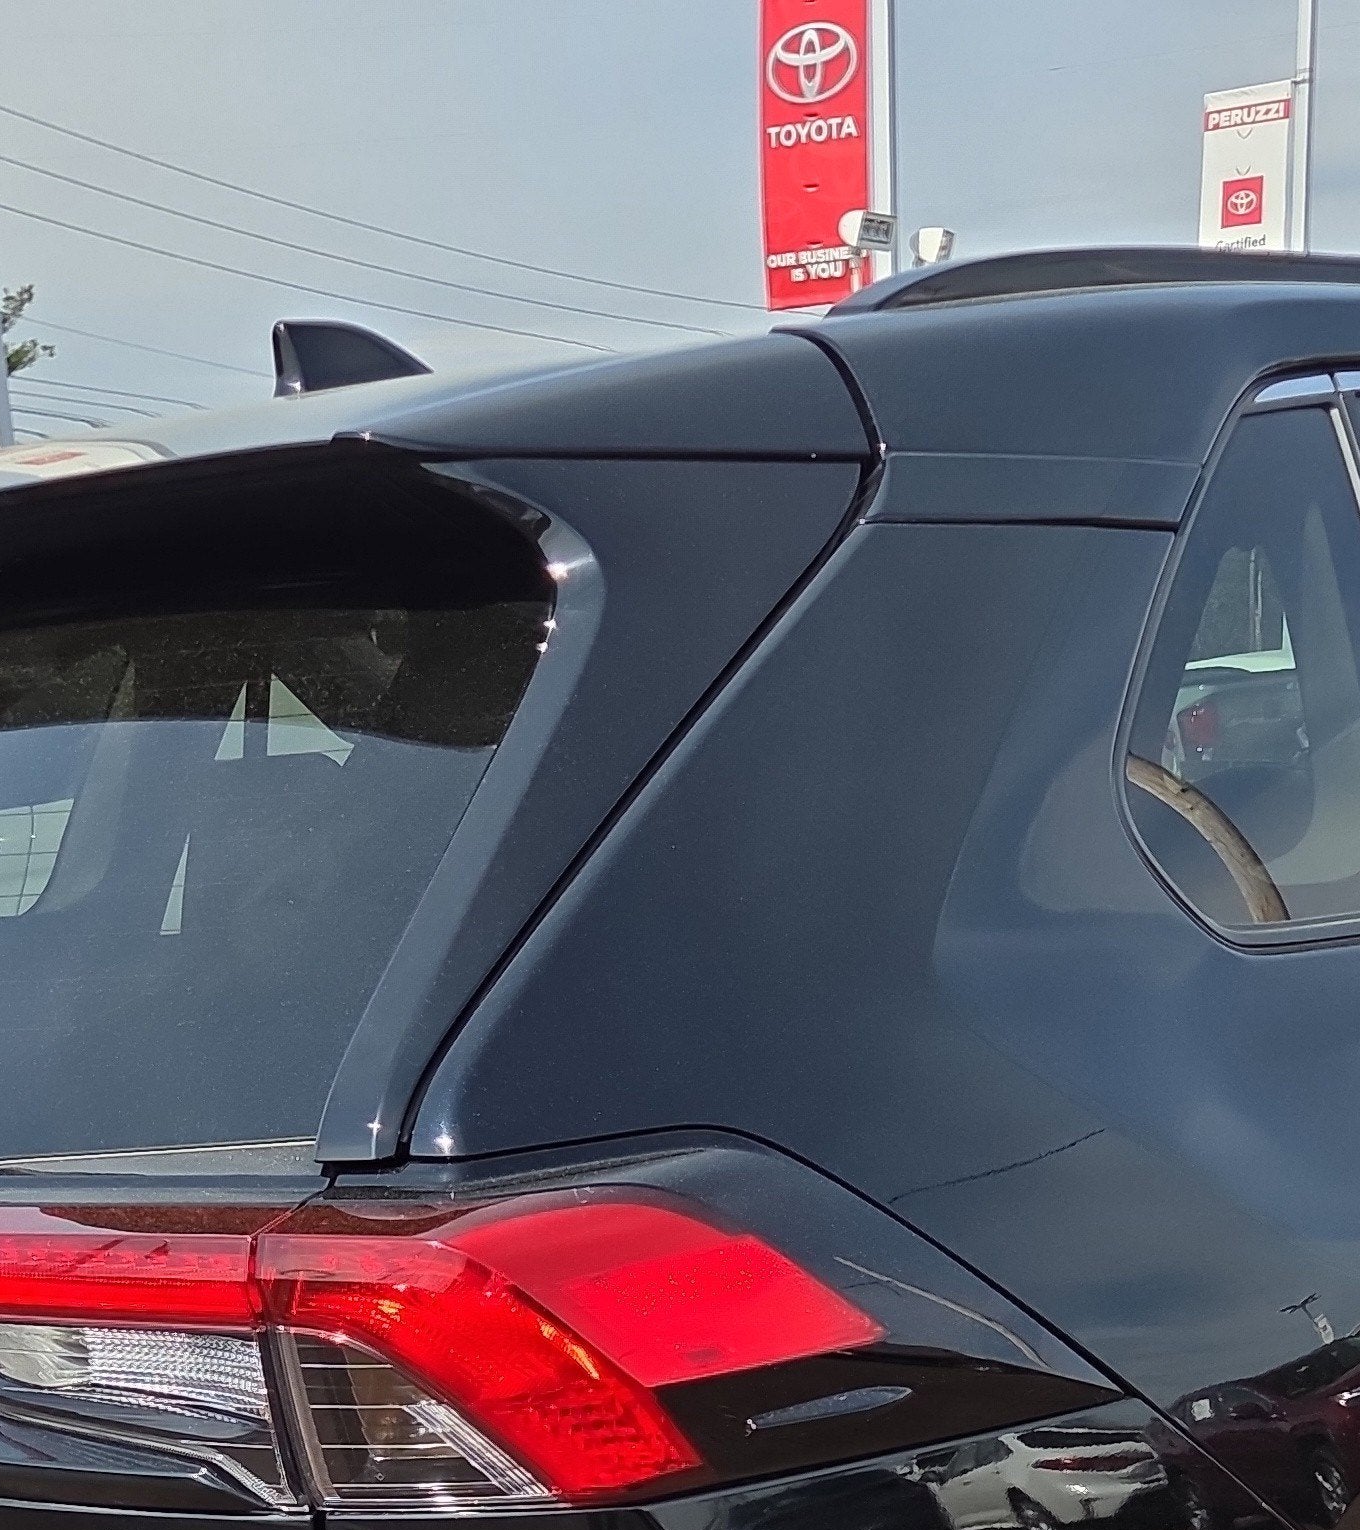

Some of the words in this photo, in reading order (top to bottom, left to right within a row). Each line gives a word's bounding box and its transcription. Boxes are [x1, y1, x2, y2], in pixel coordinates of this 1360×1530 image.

[1207, 101, 1285, 130] PERUZZI
[766, 115, 859, 149] TOYOTA
[766, 251, 797, 269] OUR
[807, 261, 845, 280] YOU
